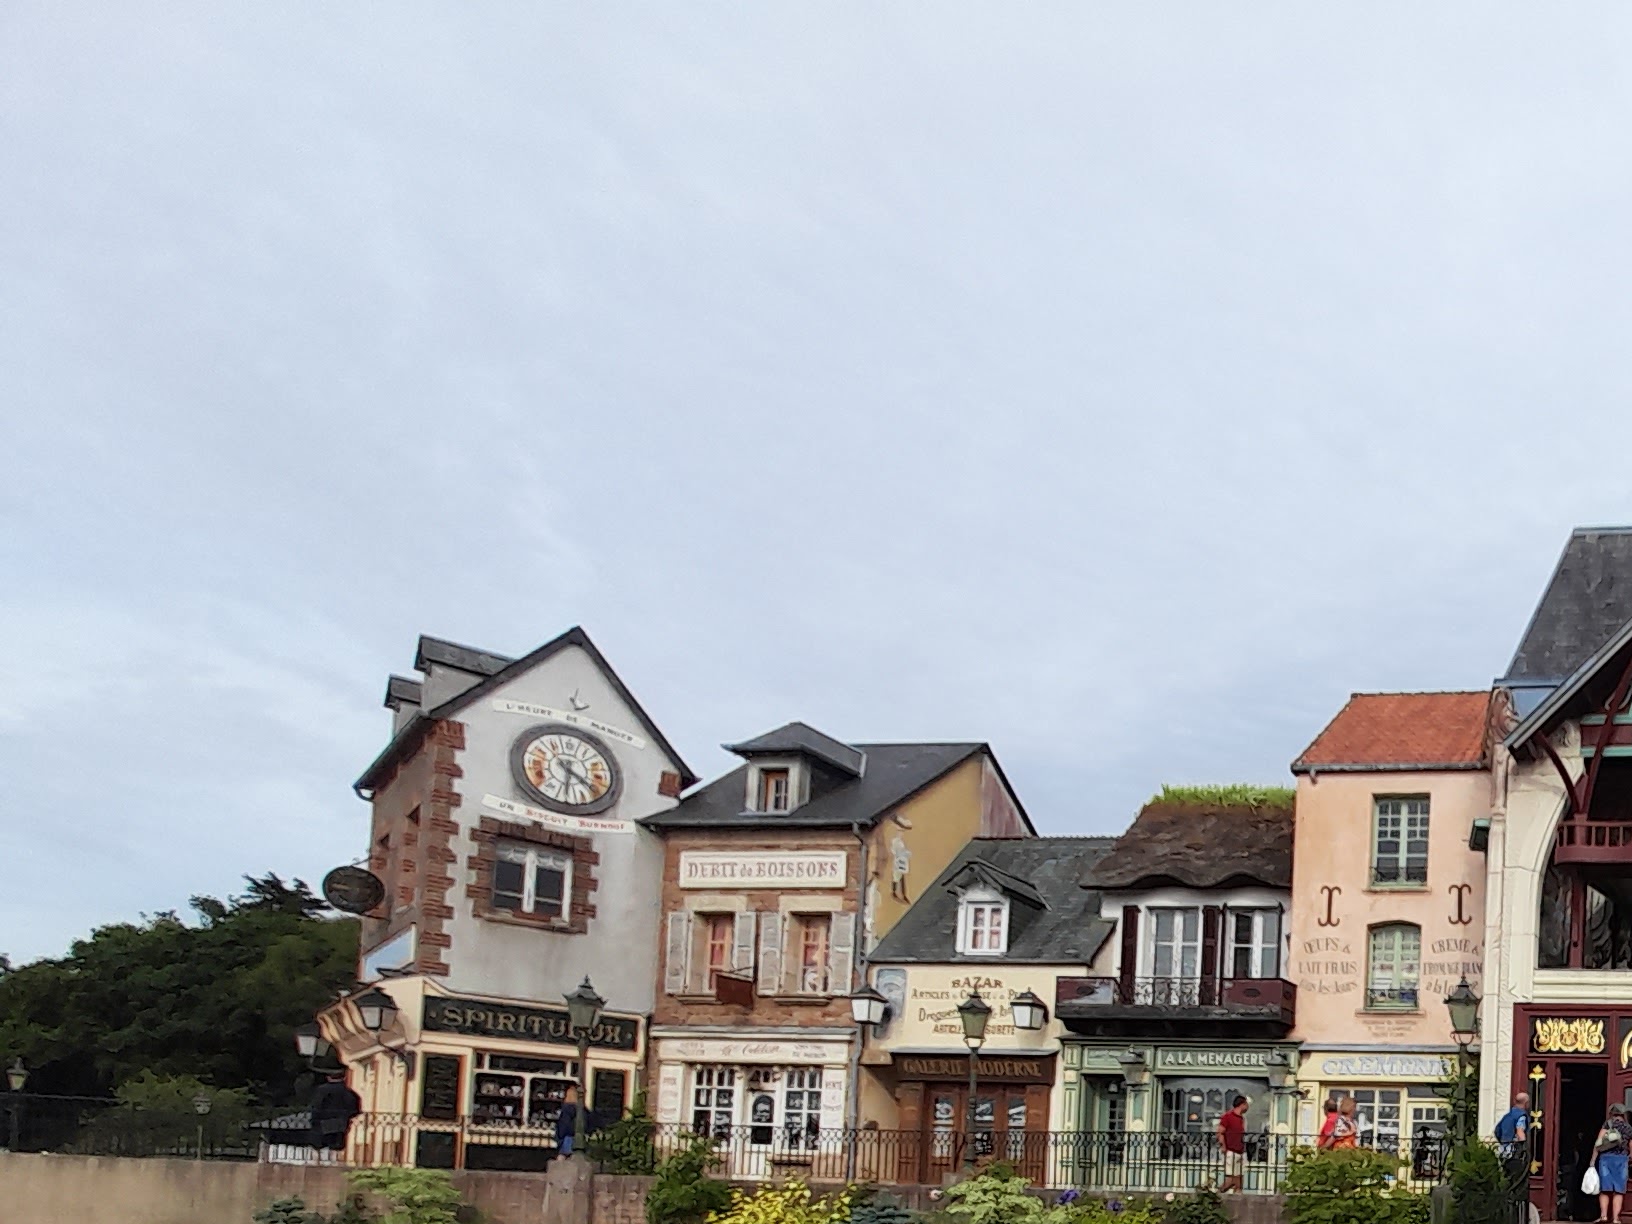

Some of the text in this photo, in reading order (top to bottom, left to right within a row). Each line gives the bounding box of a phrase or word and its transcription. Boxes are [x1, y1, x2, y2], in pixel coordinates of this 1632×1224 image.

[951, 976, 1003, 989] BAZAR
[1165, 1053, 1266, 1067] A LA MENAGERE
